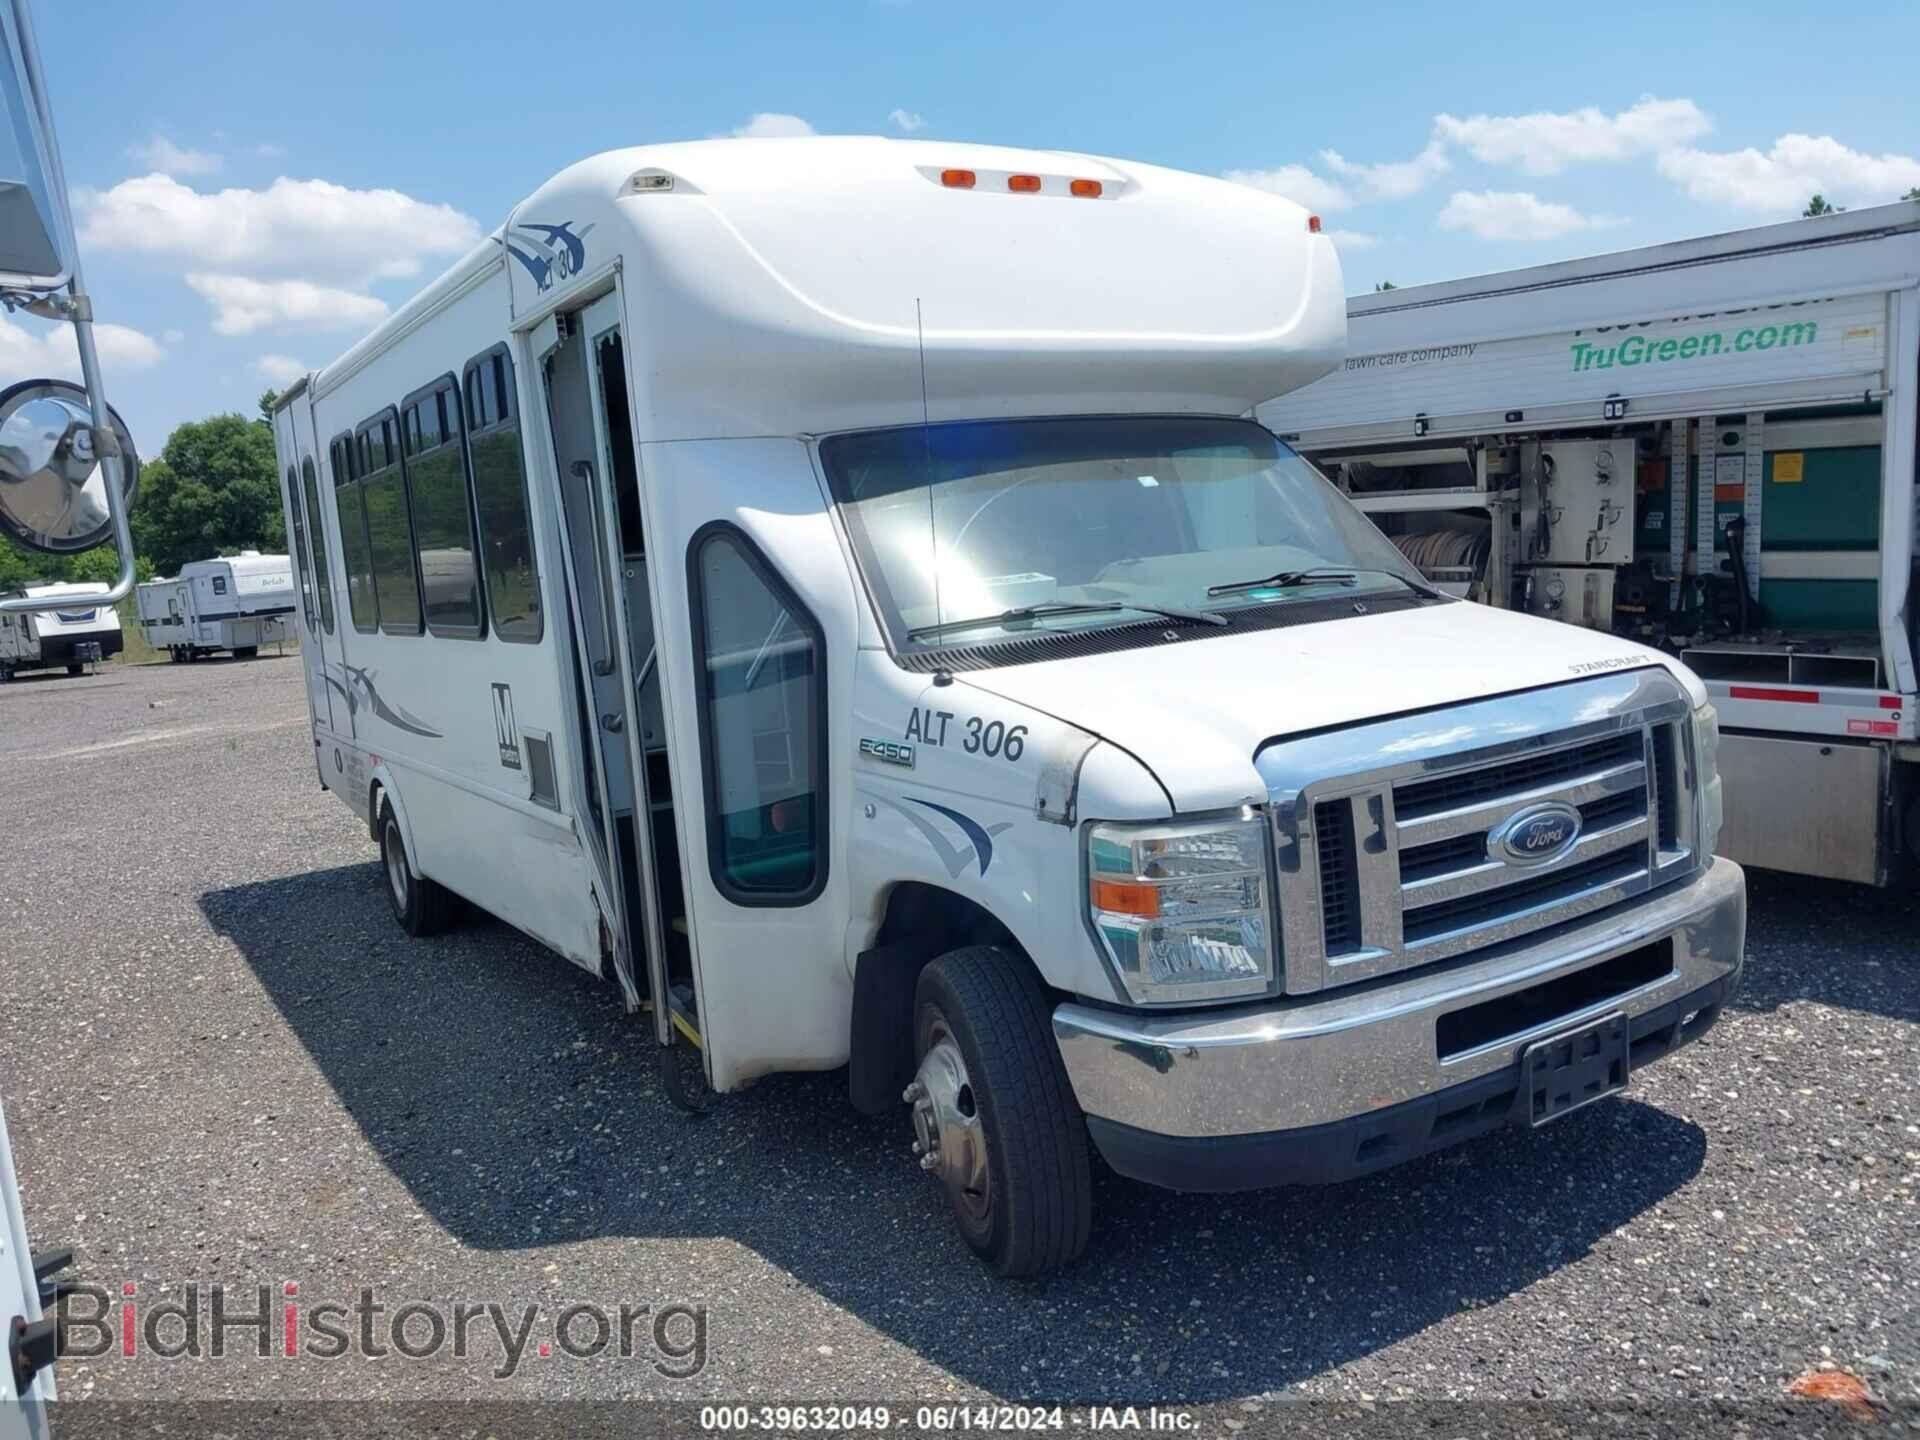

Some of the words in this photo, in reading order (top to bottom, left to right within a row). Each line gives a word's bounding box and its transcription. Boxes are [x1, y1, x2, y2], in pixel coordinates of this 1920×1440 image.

[1379, 352, 1408, 367] care
[1411, 342, 1478, 362] company
[1570, 319, 1818, 372] TruGreen.com
[1567, 654, 1650, 674] STARCRAFT
[905, 706, 955, 748] ALT
[962, 716, 1029, 762] 306
[1526, 819, 1564, 849] Ford
